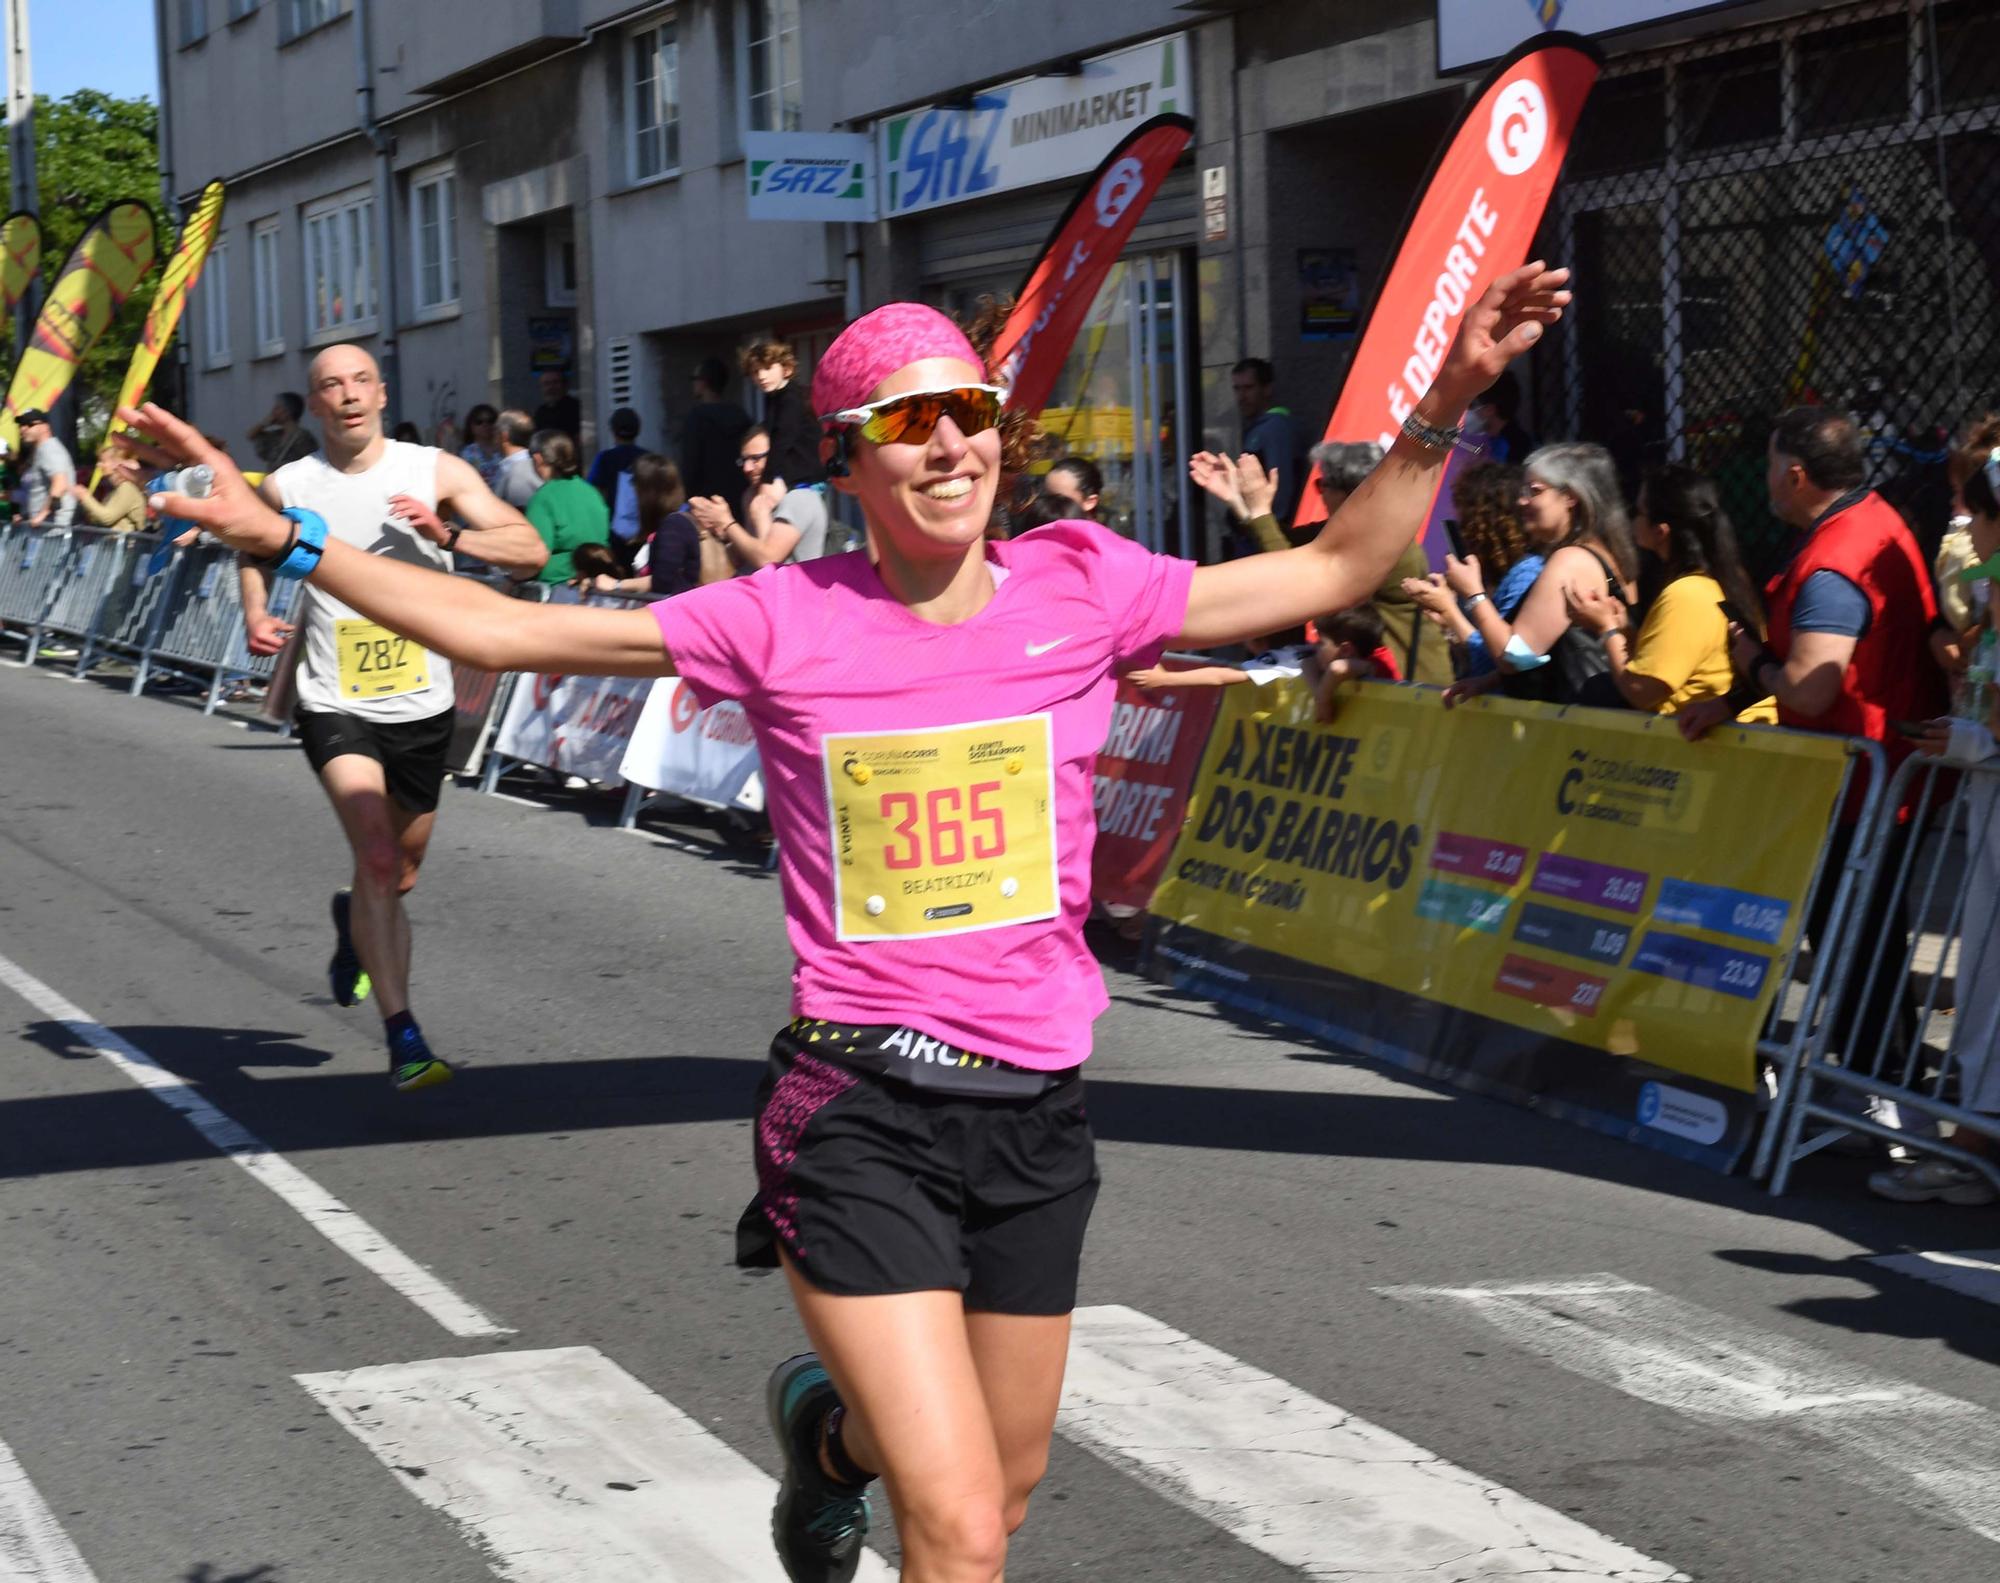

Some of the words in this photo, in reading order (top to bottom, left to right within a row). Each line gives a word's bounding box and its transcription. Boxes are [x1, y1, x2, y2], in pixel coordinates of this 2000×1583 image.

[902, 91, 1009, 207] SAZ
[1010, 82, 1153, 148] MINIMARKET
[766, 166, 846, 193] SAZ
[1401, 186, 1499, 400] DEPORTE
[355, 636, 408, 673] 282
[1216, 718, 1244, 779] A
[1245, 722, 1360, 800] XENTE
[839, 805, 852, 854] TANDA
[880, 781, 1006, 870] 365
[1195, 784, 1274, 854] DOS
[1264, 800, 1419, 891] BARRIOS
